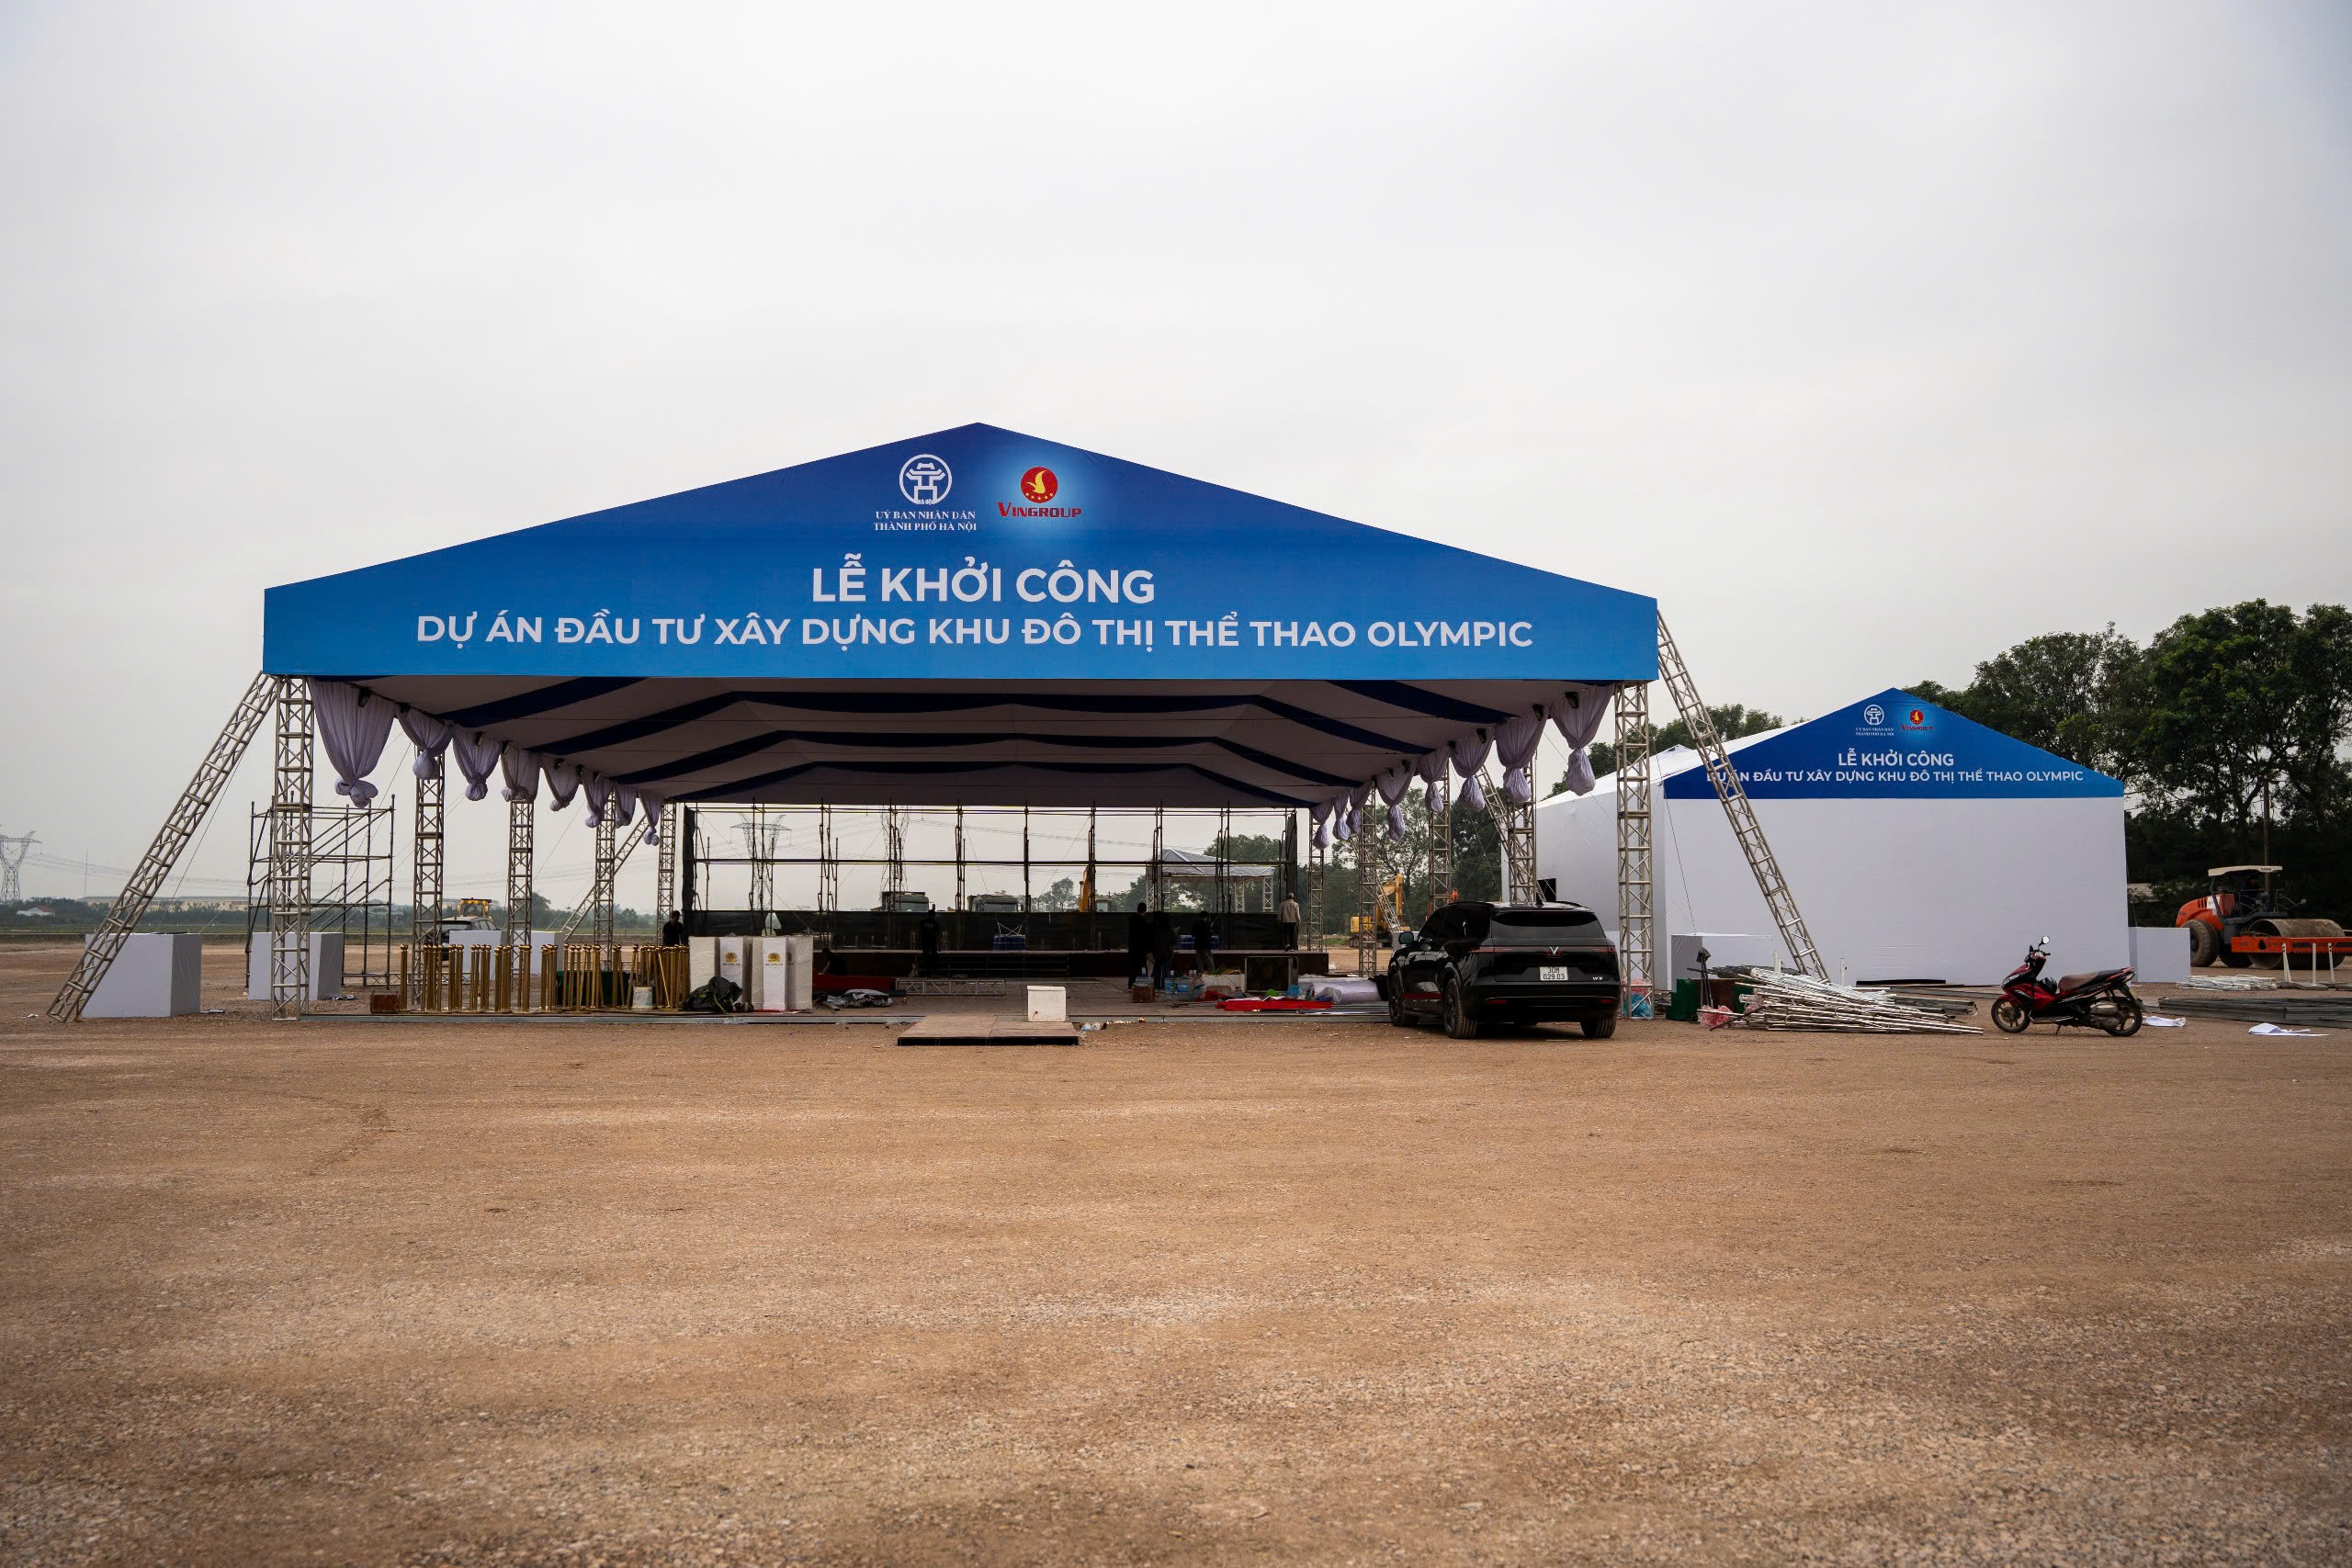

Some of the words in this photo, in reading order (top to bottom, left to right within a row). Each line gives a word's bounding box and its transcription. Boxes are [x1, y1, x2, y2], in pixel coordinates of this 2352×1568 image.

[894, 511, 916, 520] BAN
[918, 510, 950, 520] NHÂN
[952, 510, 976, 520] DÂN
[998, 502, 1082, 518] VINGROUP
[874, 521, 912, 531] THÀNH
[914, 521, 937, 531] PHỐ
[939, 521, 956, 531] HÀ
[957, 521, 977, 533] NỘI
[813, 553, 865, 602] LỄ
[882, 557, 1001, 602] KHỞI
[1016, 559, 1154, 604] CÔNG
[418, 611, 477, 649] DỰ
[485, 610, 541, 642] ÁN
[555, 609, 639, 644] ĐẦU
[652, 614, 705, 644] TƯ
[714, 613, 790, 644] XÂY
[803, 614, 914, 651] DỰNG
[930, 619, 1009, 644] KHU
[1022, 613, 1080, 644] ĐÔ
[1092, 620, 1152, 652] THỊ
[1165, 612, 1238, 646] THỂ
[1250, 622, 1355, 647] THAO
[1368, 622, 1532, 647] OLYMPIC
[1838, 748, 1857, 765] LỄ
[1862, 750, 1902, 766] KHỞI
[1907, 750, 1953, 766] CÔNG
[1753, 769, 1781, 781] ĐẦU
[1785, 771, 1804, 781] TƯ
[1807, 770, 1832, 781] XÂY
[1836, 770, 1873, 783] DỰNG
[1879, 772, 1905, 781] KHU
[1909, 770, 1929, 781] ĐÔ
[1933, 772, 1953, 784] THỊ
[1958, 769, 1983, 781] THỂ
[1986, 772, 2022, 781] THAO
[2027, 772, 2083, 781] OLYMPIC
